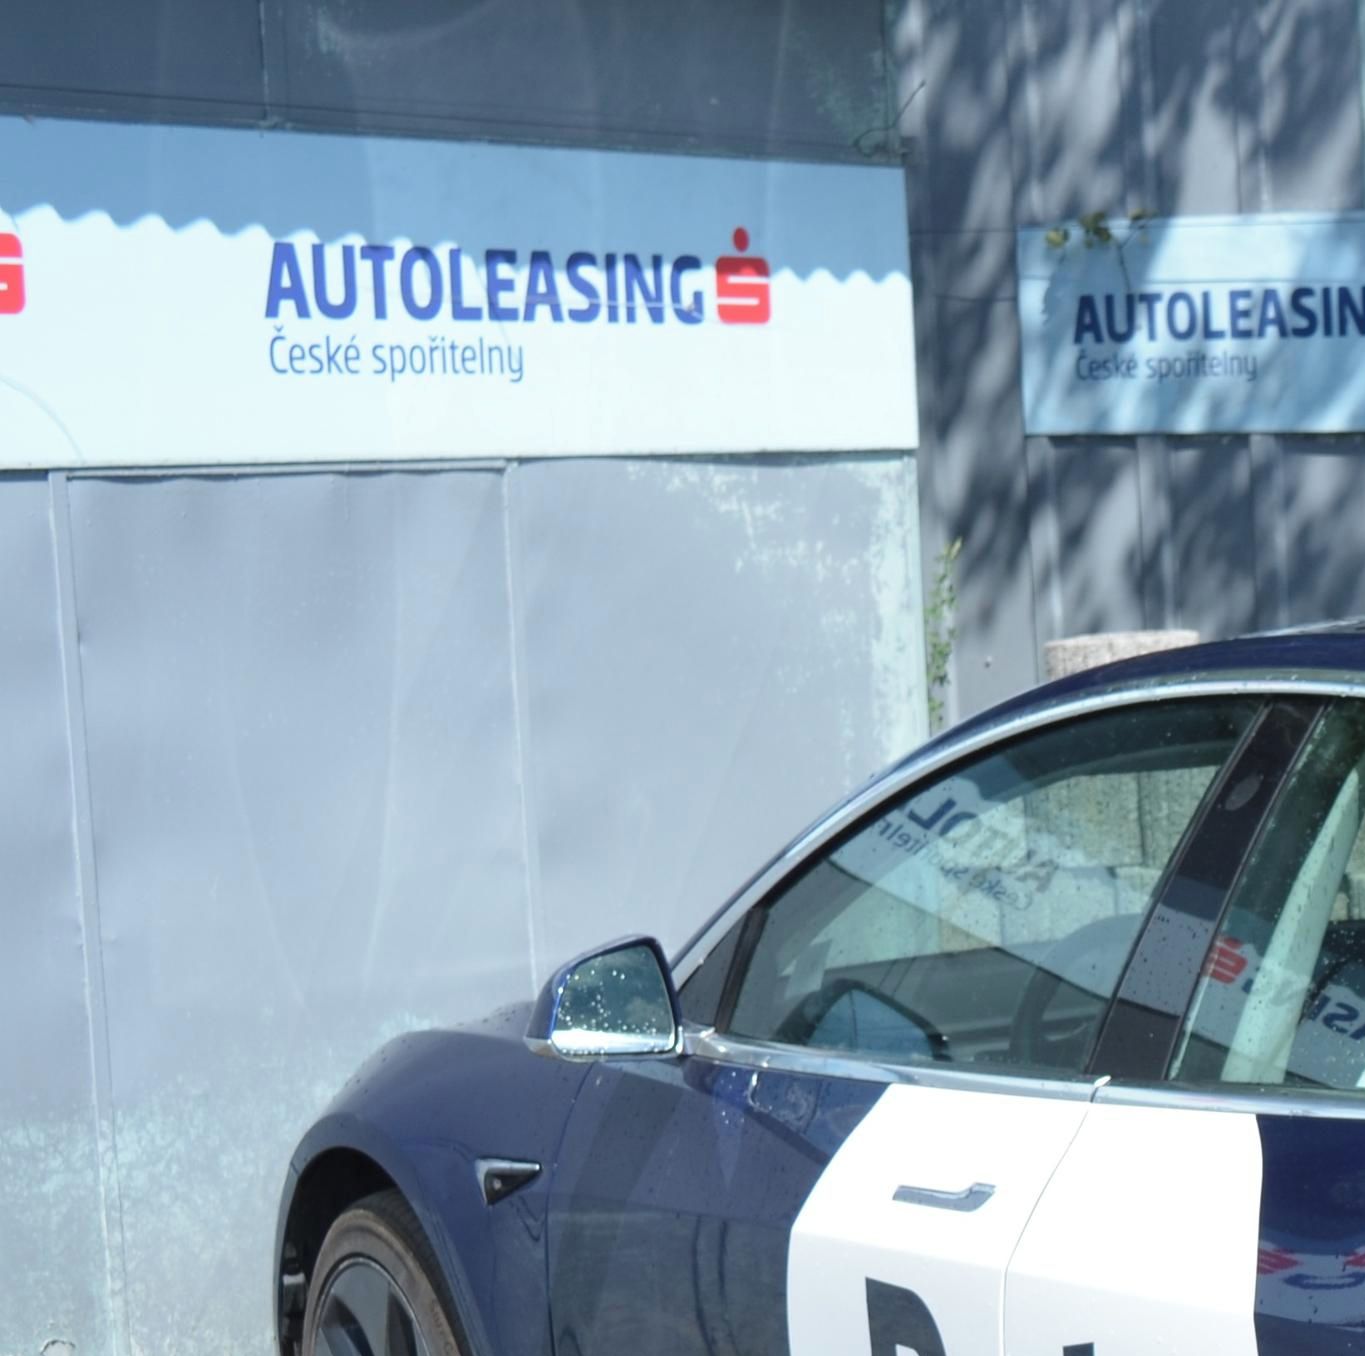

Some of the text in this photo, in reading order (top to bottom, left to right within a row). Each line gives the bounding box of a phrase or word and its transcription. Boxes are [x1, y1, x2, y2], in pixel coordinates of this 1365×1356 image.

[264, 241, 705, 324] AUTOLEASING
[269, 326, 525, 383] České spořitelny
[1075, 349, 1258, 383] České spořitelny
